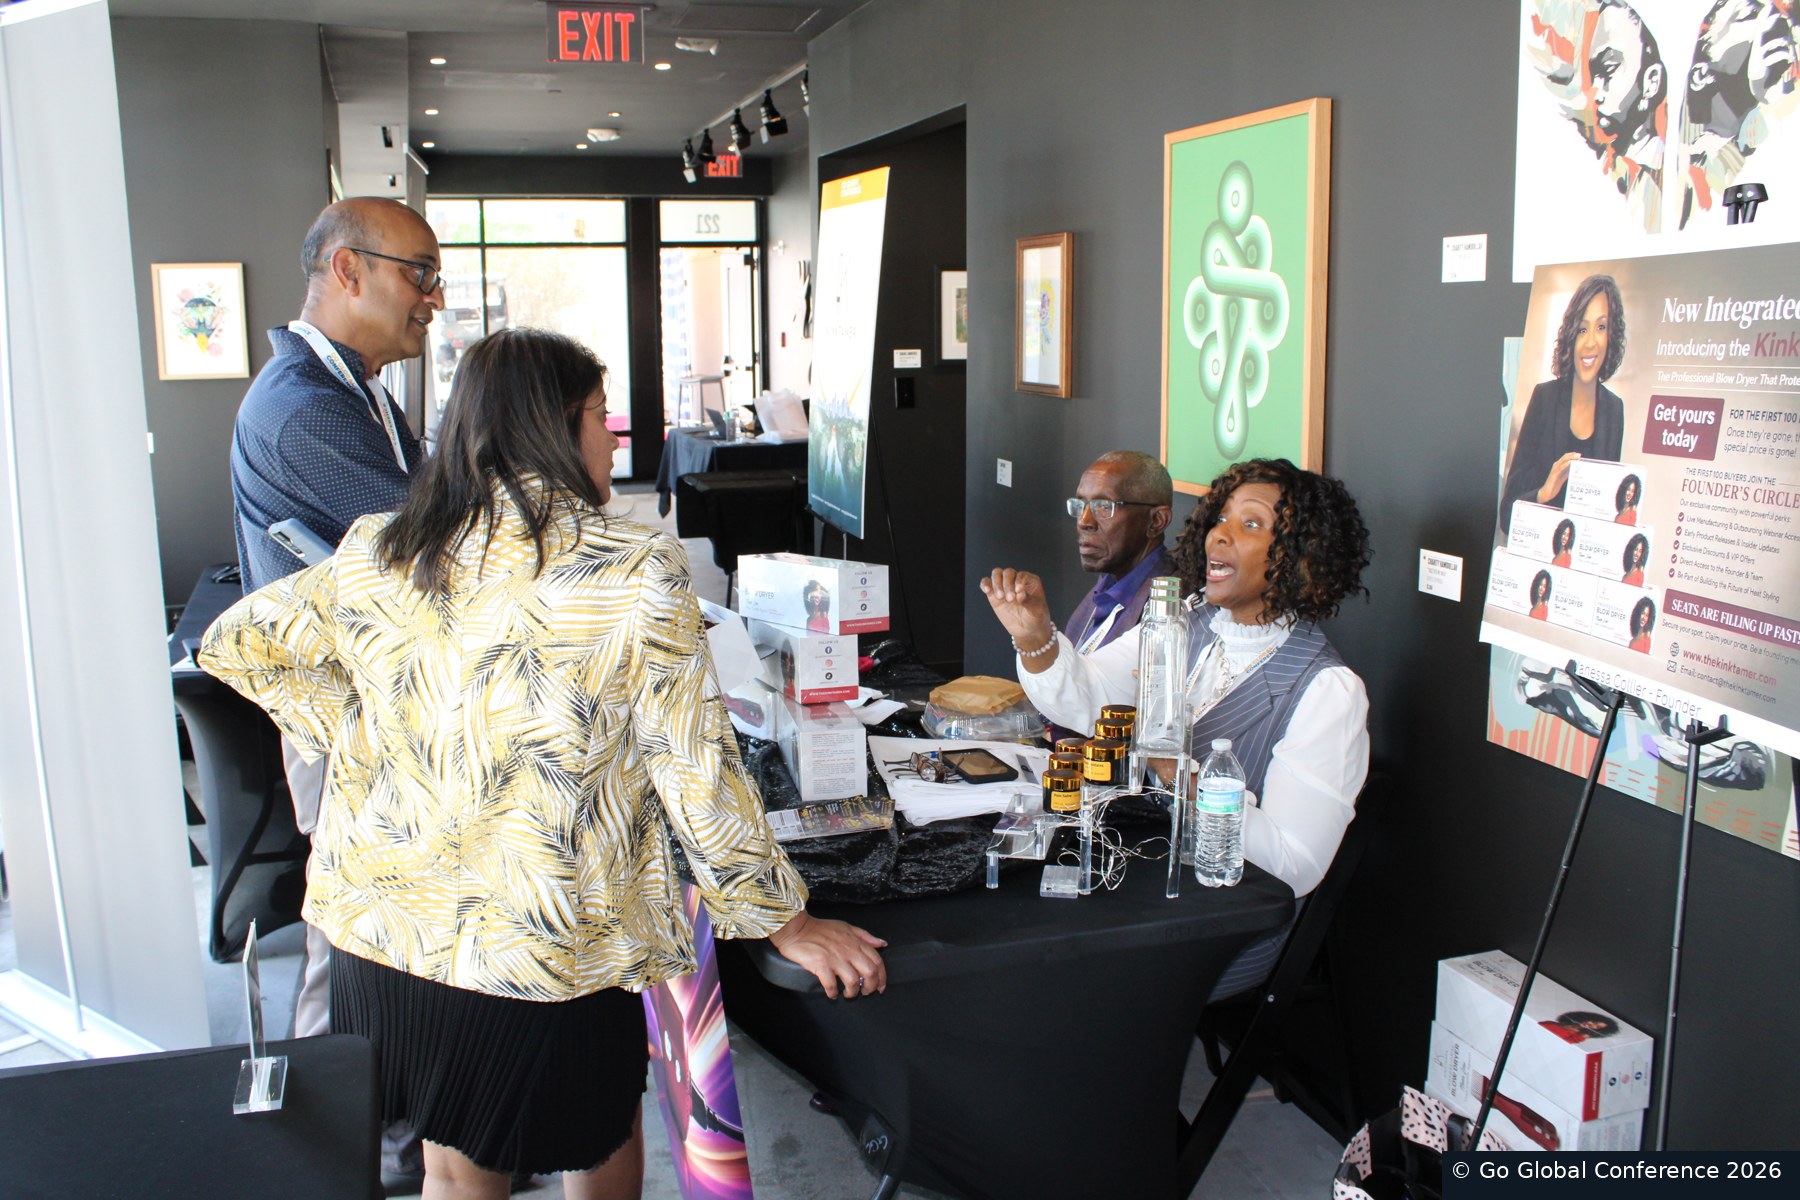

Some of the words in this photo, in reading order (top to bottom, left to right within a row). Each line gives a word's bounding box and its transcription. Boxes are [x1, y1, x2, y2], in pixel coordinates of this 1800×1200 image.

[558, 11, 635, 62] EXIT
[1661, 297, 1702, 323] New
[1656, 338, 1726, 361] Introducing
[1729, 338, 1751, 357] the
[1754, 331, 1800, 357] Kink
[1657, 371, 1670, 381] The
[1671, 371, 1715, 384] Professional
[1716, 373, 1735, 384] Blow
[1736, 373, 1758, 387] Dryer
[1759, 374, 1777, 386] That
[1654, 403, 1677, 422] Get
[1677, 407, 1715, 427] yours
[1729, 409, 1744, 419] FOR
[1746, 410, 1759, 421] THE
[1761, 411, 1782, 422] FIRST
[1783, 412, 1797, 423] 100
[1662, 429, 1698, 453] today
[1726, 426, 1745, 438] Once
[1746, 428, 1771, 441] they're
[1772, 432, 1793, 443] gone,
[1723, 442, 1748, 452] special
[1749, 445, 1767, 456] price
[1768, 446, 1775, 455] is
[1775, 447, 1797, 459] gone!
[1686, 467, 1697, 476] THE
[1697, 469, 1713, 478] FIRST
[1713, 470, 1723, 479] 100
[1724, 472, 1747, 482] BUYERS
[1747, 475, 1763, 484] JOIN
[1765, 476, 1776, 486] THE
[1681, 478, 1750, 502] FOUNDER'S
[1753, 488, 1800, 509] CIRCLE
[1680, 498, 1689, 507] Our
[1689, 500, 1711, 511] exclusive
[1711, 504, 1739, 516] community
[1739, 508, 1751, 517] with
[1751, 509, 1775, 521] powerful
[1686, 515, 1696, 523] Live
[1696, 516, 1729, 530] Manufacturing
[1733, 523, 1763, 537] Outsourcing
[1763, 528, 1784, 539] Webinar
[1684, 529, 1696, 539] Early
[1696, 532, 1714, 542] Product
[1715, 535, 1736, 546] Releases
[1741, 540, 1758, 550] Insider
[1758, 542, 1780, 554] Updates
[1682, 543, 1702, 553] Exclusive
[1702, 547, 1726, 558] Discounts
[1731, 553, 1740, 561] VIP
[1740, 555, 1755, 565] Offers
[1679, 557, 1693, 567] Direct
[1694, 560, 1710, 570] Access
[1716, 565, 1724, 573] the
[1725, 567, 1745, 579] Founder
[1750, 572, 1764, 581] Team
[1684, 572, 1693, 581] Part
[1699, 576, 1718, 589] Building
[1719, 580, 1727, 588] the
[1727, 583, 1743, 593] Future
[1750, 588, 1762, 597] Heat
[1763, 591, 1780, 603] Styling
[1671, 599, 1699, 616] SEATS
[1700, 607, 1719, 622] ARE
[1720, 611, 1757, 632] FILLING
[1758, 621, 1773, 636] UP
[1773, 625, 1800, 645] FAST!
[1662, 618, 1679, 630] Secure
[1679, 625, 1691, 634] your
[1705, 631, 1721, 643] Claim
[1720, 637, 1733, 648] your
[1750, 644, 1759, 654] Be
[1763, 649, 1789, 664] founding
[1683, 649, 1777, 687] www.thekinktamer.com
[1613, 673, 1647, 698] Collier
[1656, 689, 1702, 718] Founder
[1680, 665, 1696, 677] Email:
[1696, 672, 1777, 703] contact@thekinktamer.com
